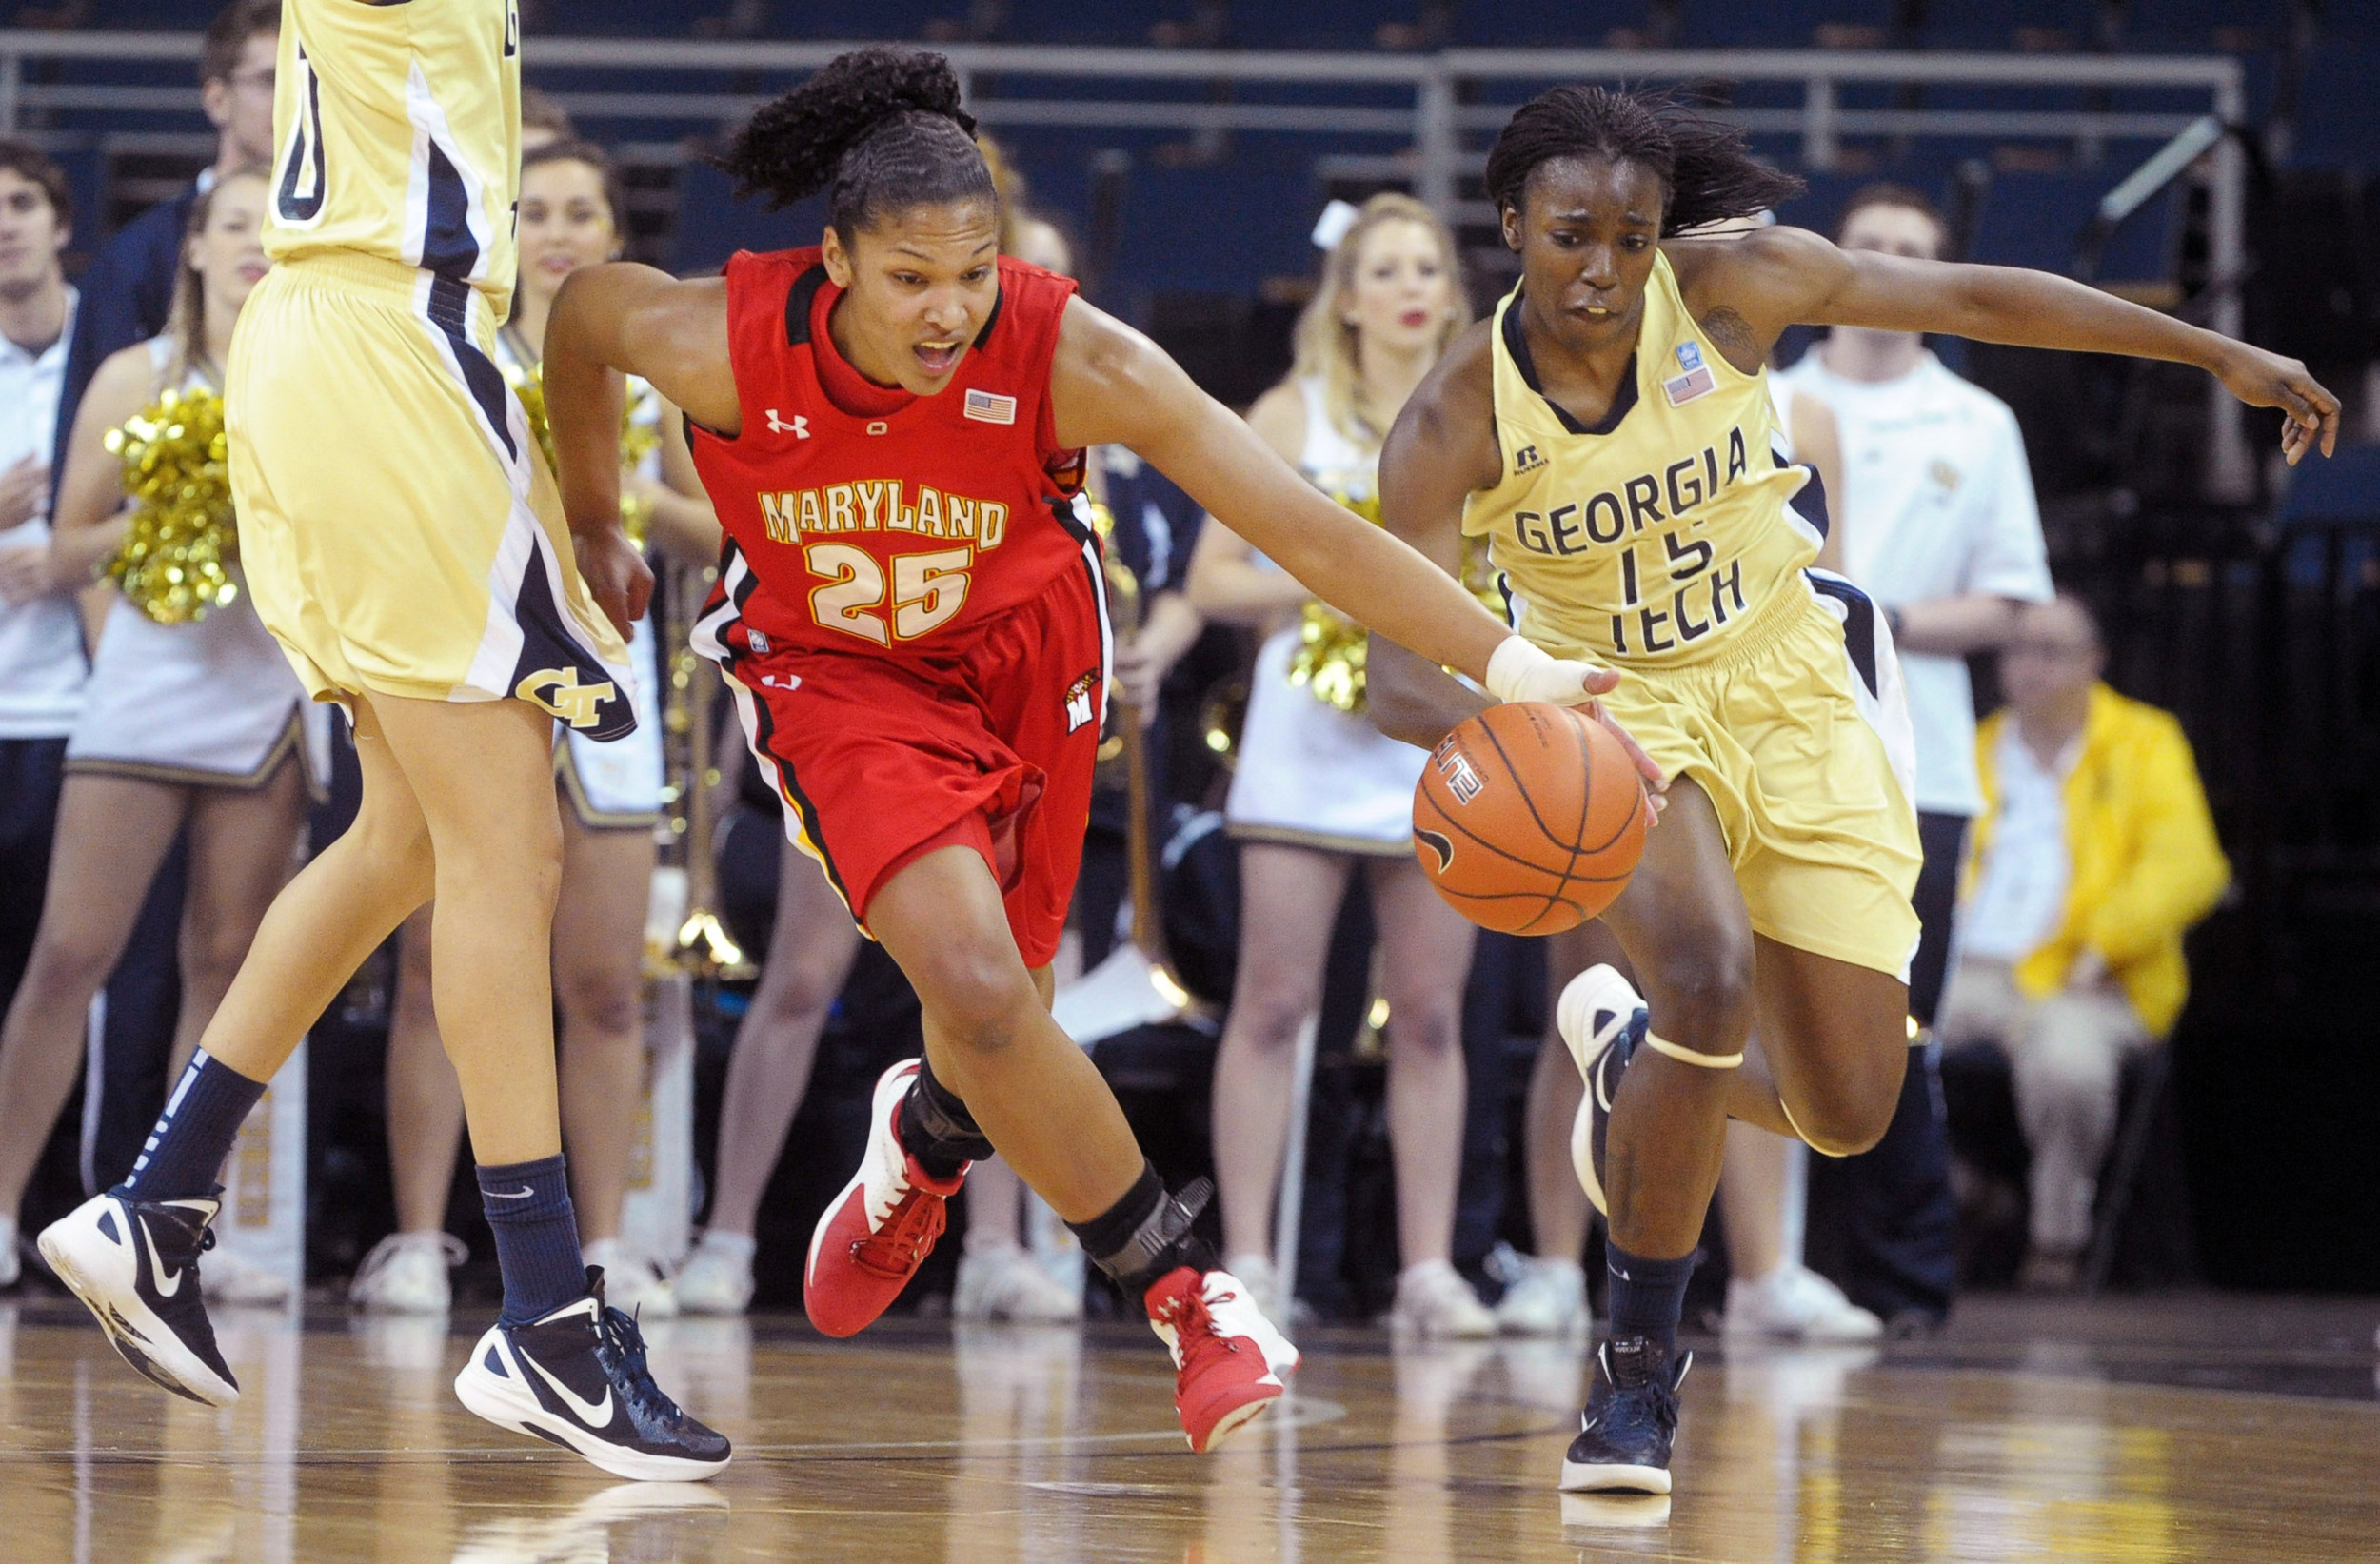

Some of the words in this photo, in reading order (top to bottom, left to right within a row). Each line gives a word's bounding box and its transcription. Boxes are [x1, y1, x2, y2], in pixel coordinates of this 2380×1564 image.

[758, 479, 1009, 552] MARYLAND
[1513, 425, 1749, 557] GEORGIA
[803, 541, 974, 649] 25
[1618, 520, 1716, 609] 15
[515, 666, 616, 728] GT
